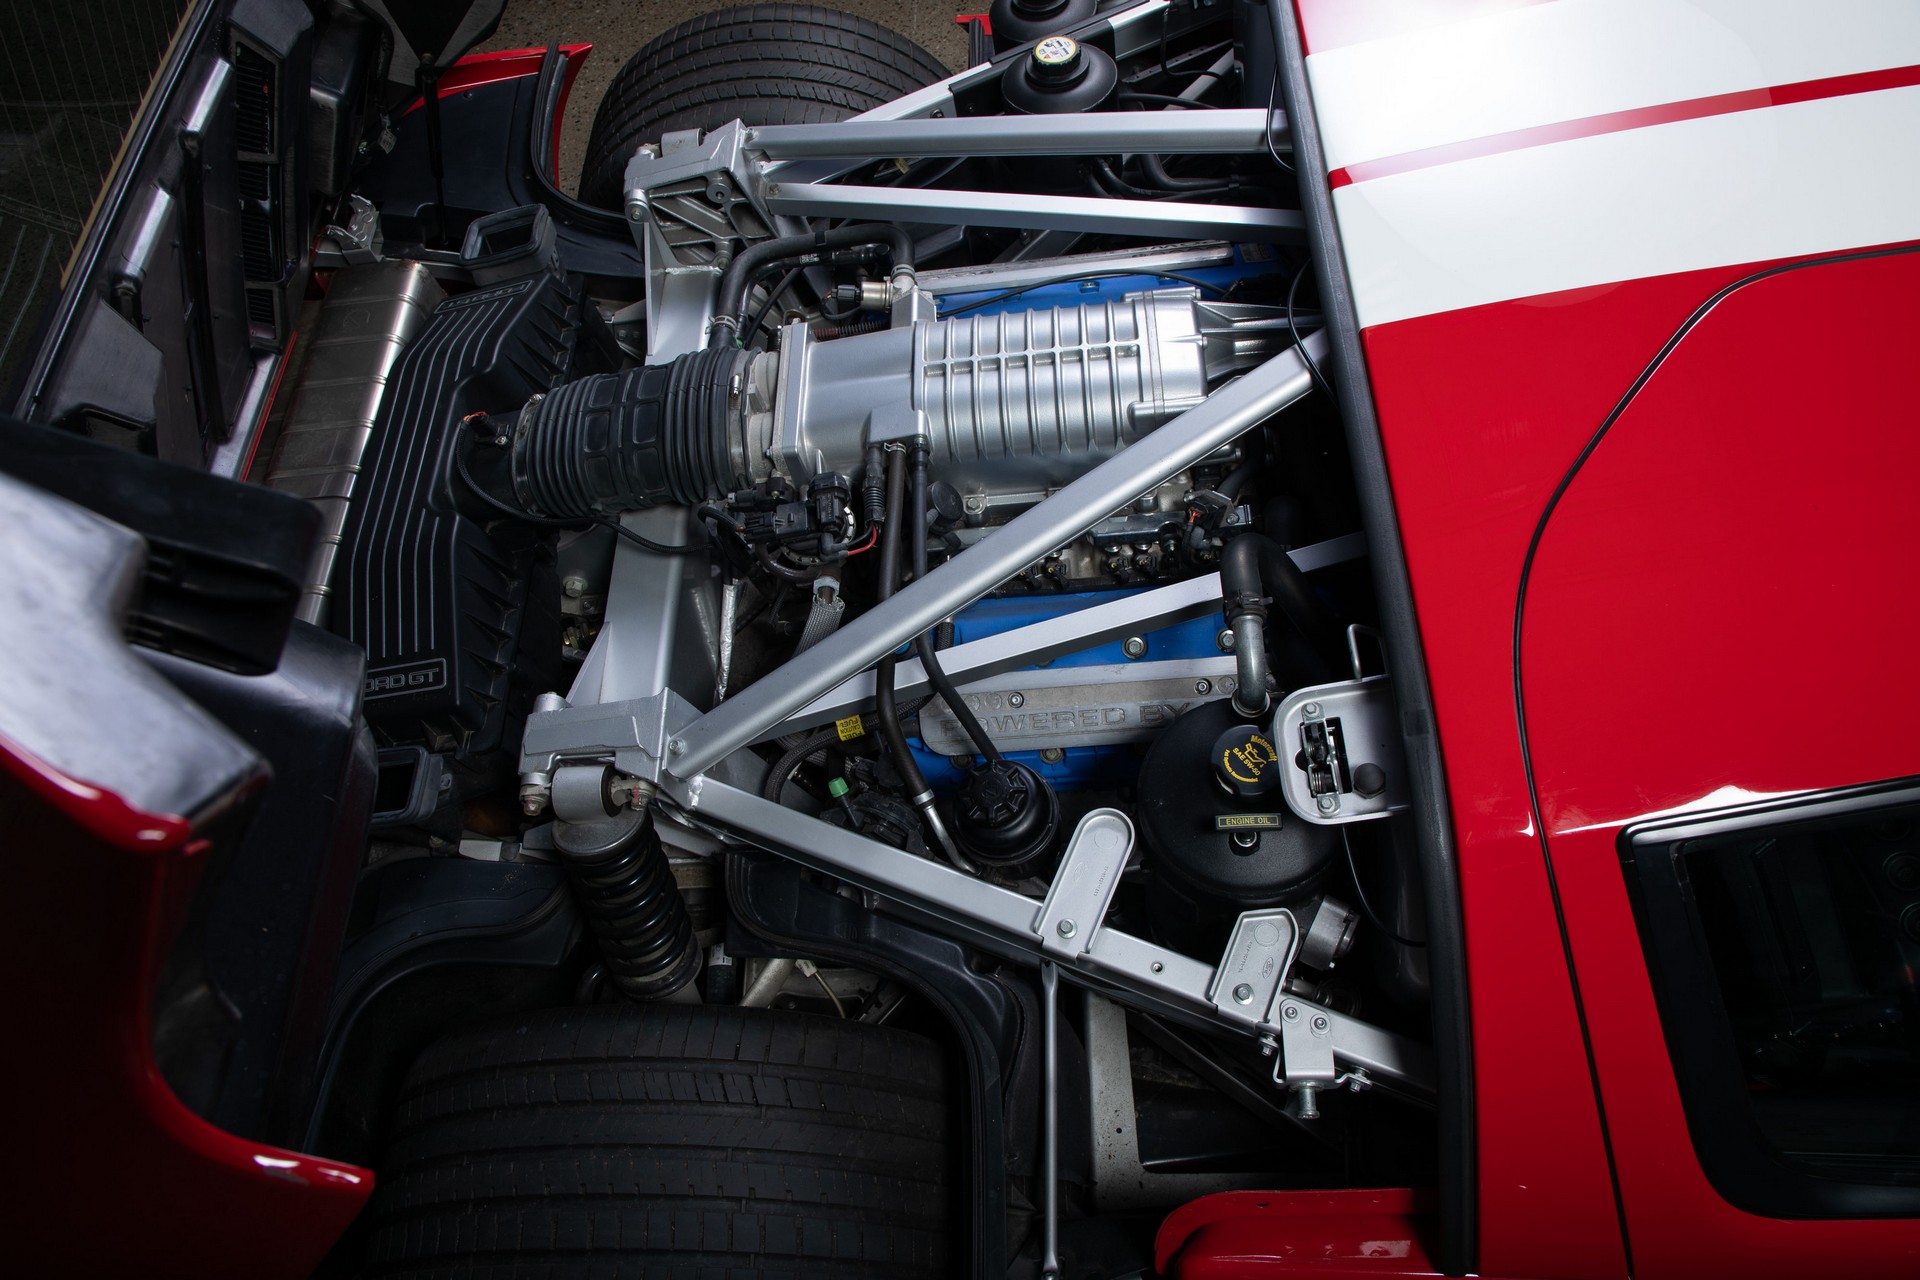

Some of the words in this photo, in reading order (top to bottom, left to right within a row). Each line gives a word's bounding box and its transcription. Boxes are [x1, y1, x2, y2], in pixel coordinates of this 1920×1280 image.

[365, 674, 405, 692] ORD
[408, 668, 439, 686] GT
[1139, 702, 1190, 723] BY
[1232, 747, 1246, 761] SAE
[1226, 817, 1255, 825] ENGINE
[1258, 816, 1270, 824] OIL
